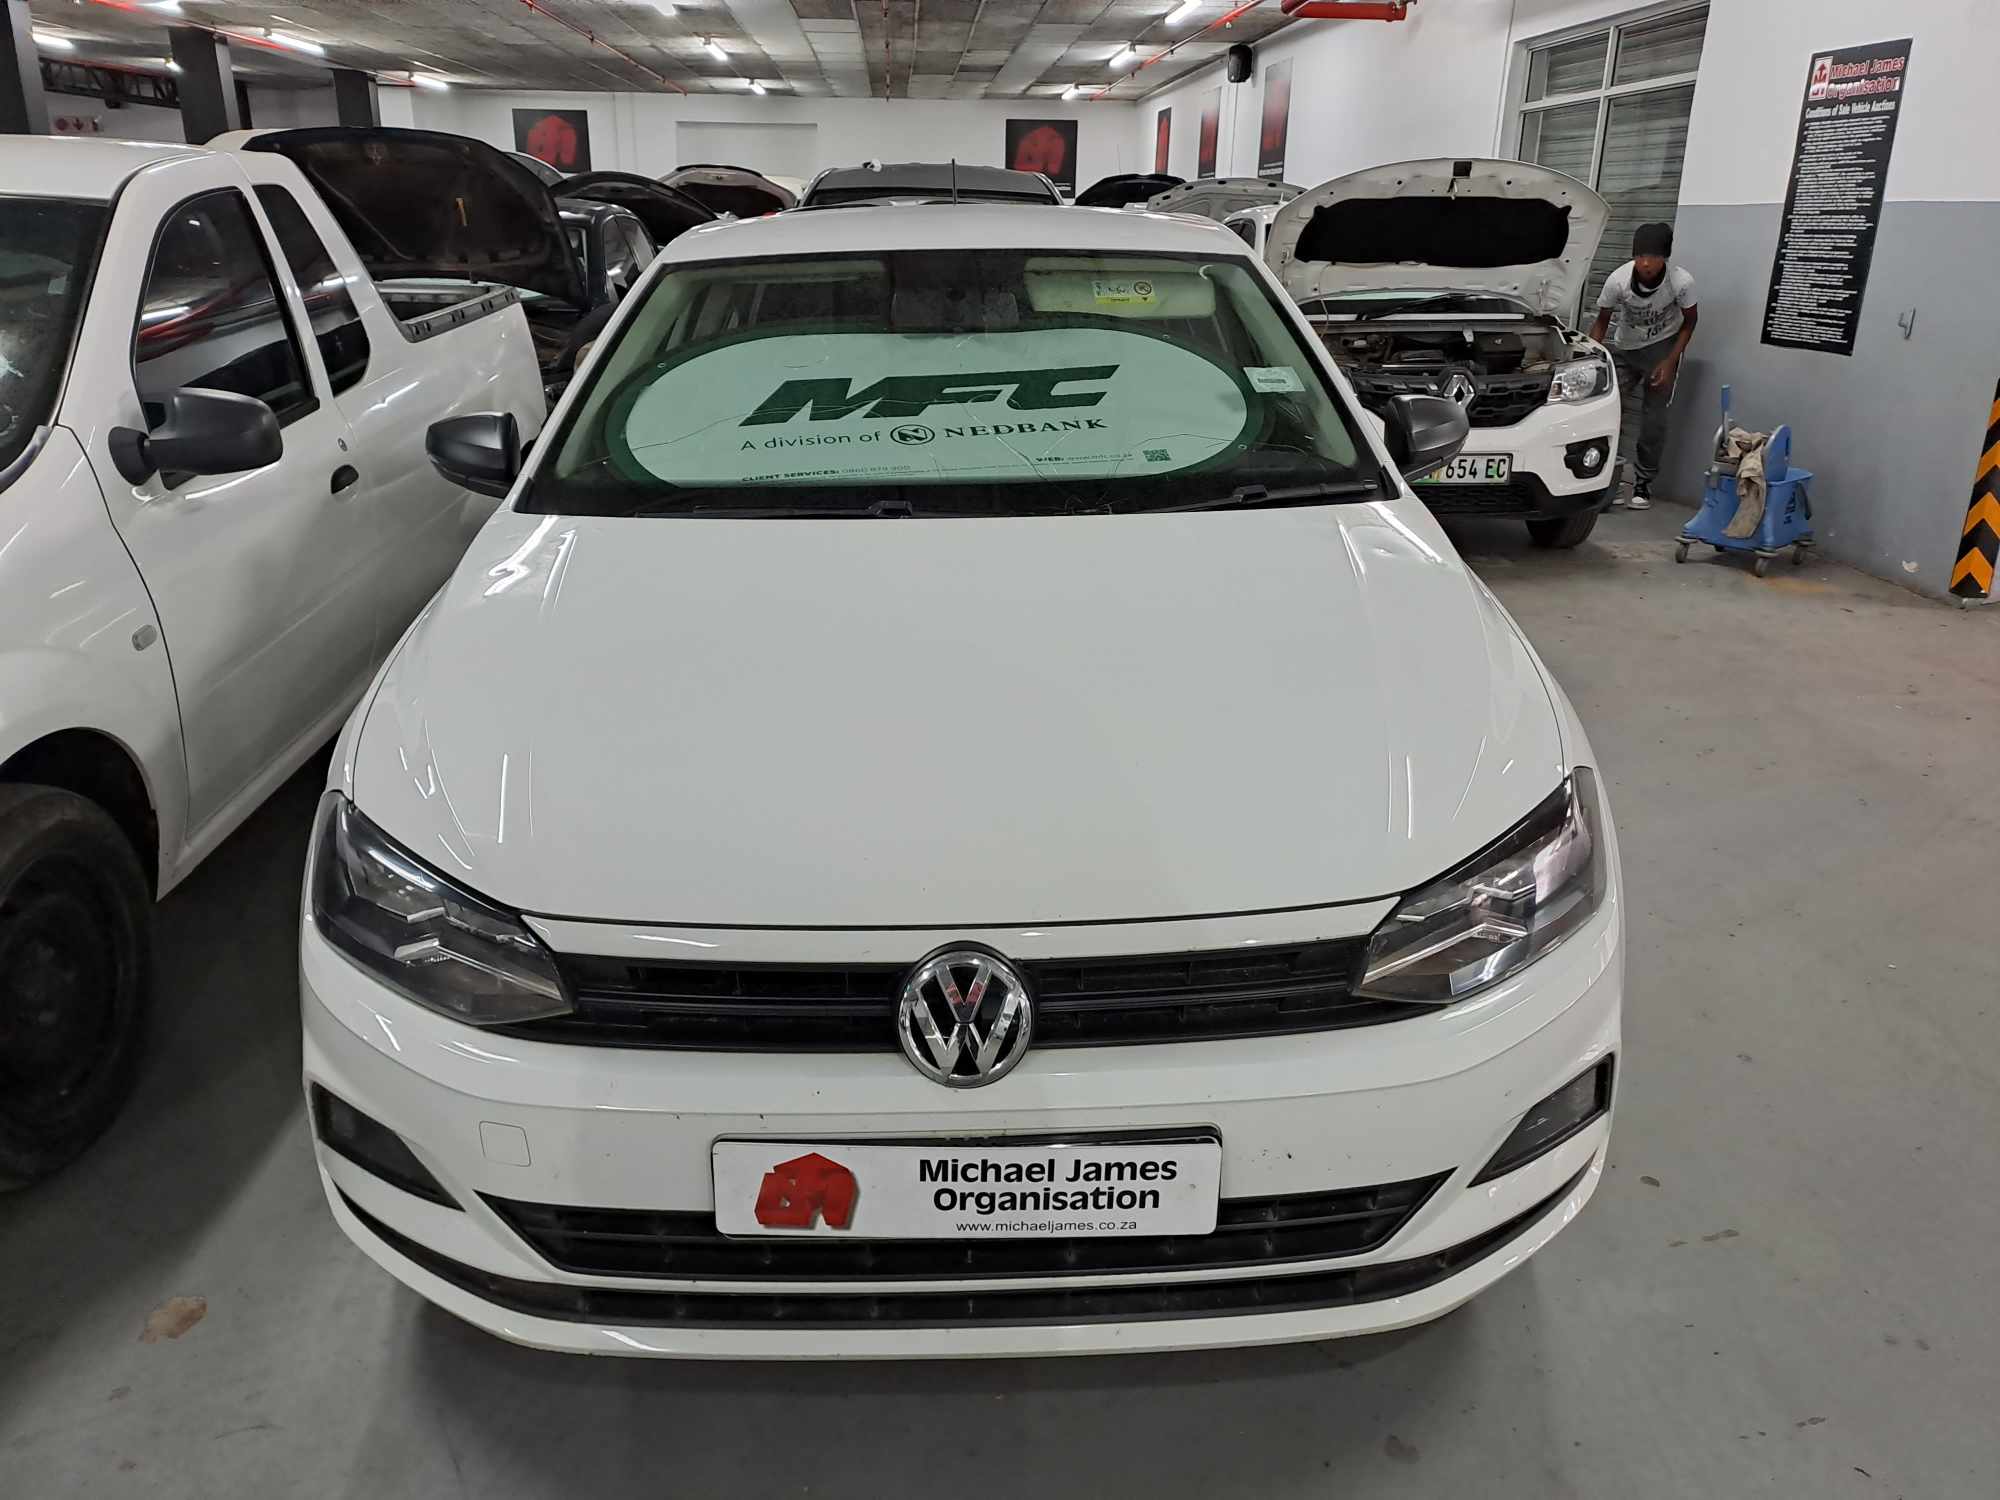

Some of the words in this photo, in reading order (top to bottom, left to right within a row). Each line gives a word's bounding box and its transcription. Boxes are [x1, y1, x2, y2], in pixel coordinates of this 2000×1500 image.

[1829, 60, 1870, 80] Michael
[1870, 57, 1905, 74] James
[1825, 76, 1901, 100] Organisation
[1851, 101, 1871, 114] Vehicle
[738, 364, 1120, 426] MFC
[740, 440, 757, 451] A
[764, 433, 851, 449] division
[859, 431, 881, 443] of
[944, 418, 1109, 439] NEDBANK
[742, 473, 780, 482] CLIENT
[783, 469, 840, 479] SERVICES:
[1445, 459, 1478, 479] 654
[1485, 458, 1507, 479] EC
[918, 1158, 1056, 1184] Michael
[1065, 1158, 1178, 1183] James
[933, 1187, 1161, 1216] Organisation
[956, 1219, 1138, 1235] www.michaeljames.co.za
